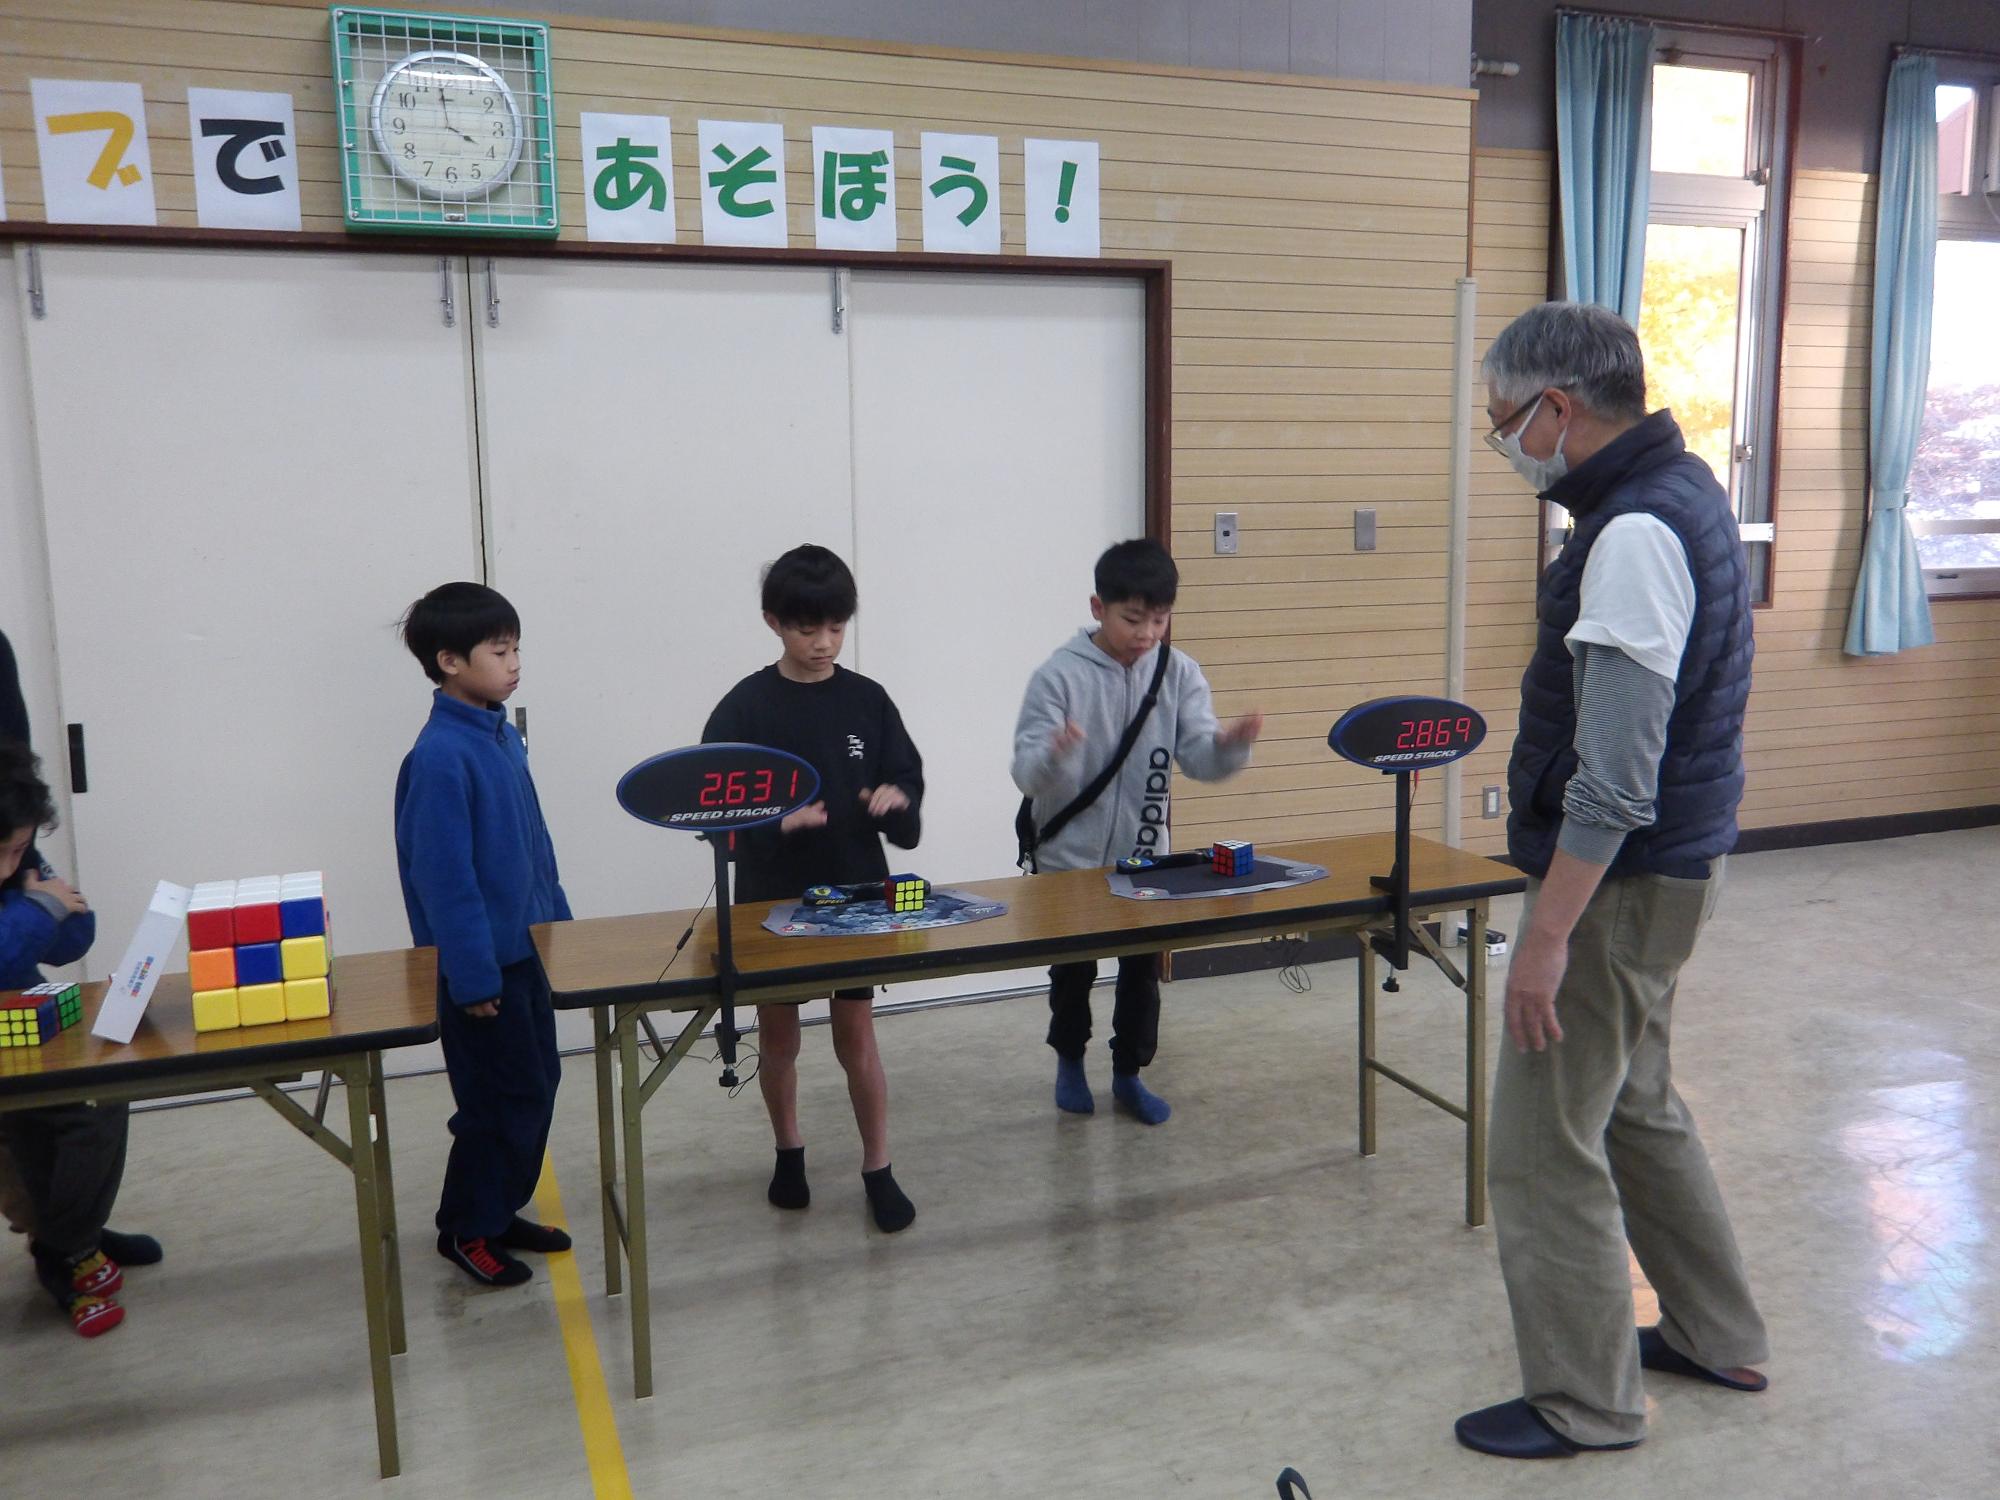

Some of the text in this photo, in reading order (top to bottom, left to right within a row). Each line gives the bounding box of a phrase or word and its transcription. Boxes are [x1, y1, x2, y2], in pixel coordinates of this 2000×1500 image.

[414, 75, 430, 93] 11
[398, 92, 416, 110] 10
[482, 96, 495, 113] 2
[392, 117, 406, 135] 9
[492, 121, 504, 138] 3
[404, 142, 417, 160] 8
[485, 144, 496, 159] 4
[422, 160, 434, 177] 7
[445, 166, 458, 184] 6
[470, 163, 481, 179] 5
[1396, 717, 1472, 749] 2.869
[1373, 749, 1457, 763] SPEED STACKS
[700, 769, 798, 806] 2.631
[669, 806, 782, 823] SPEED STACKS
